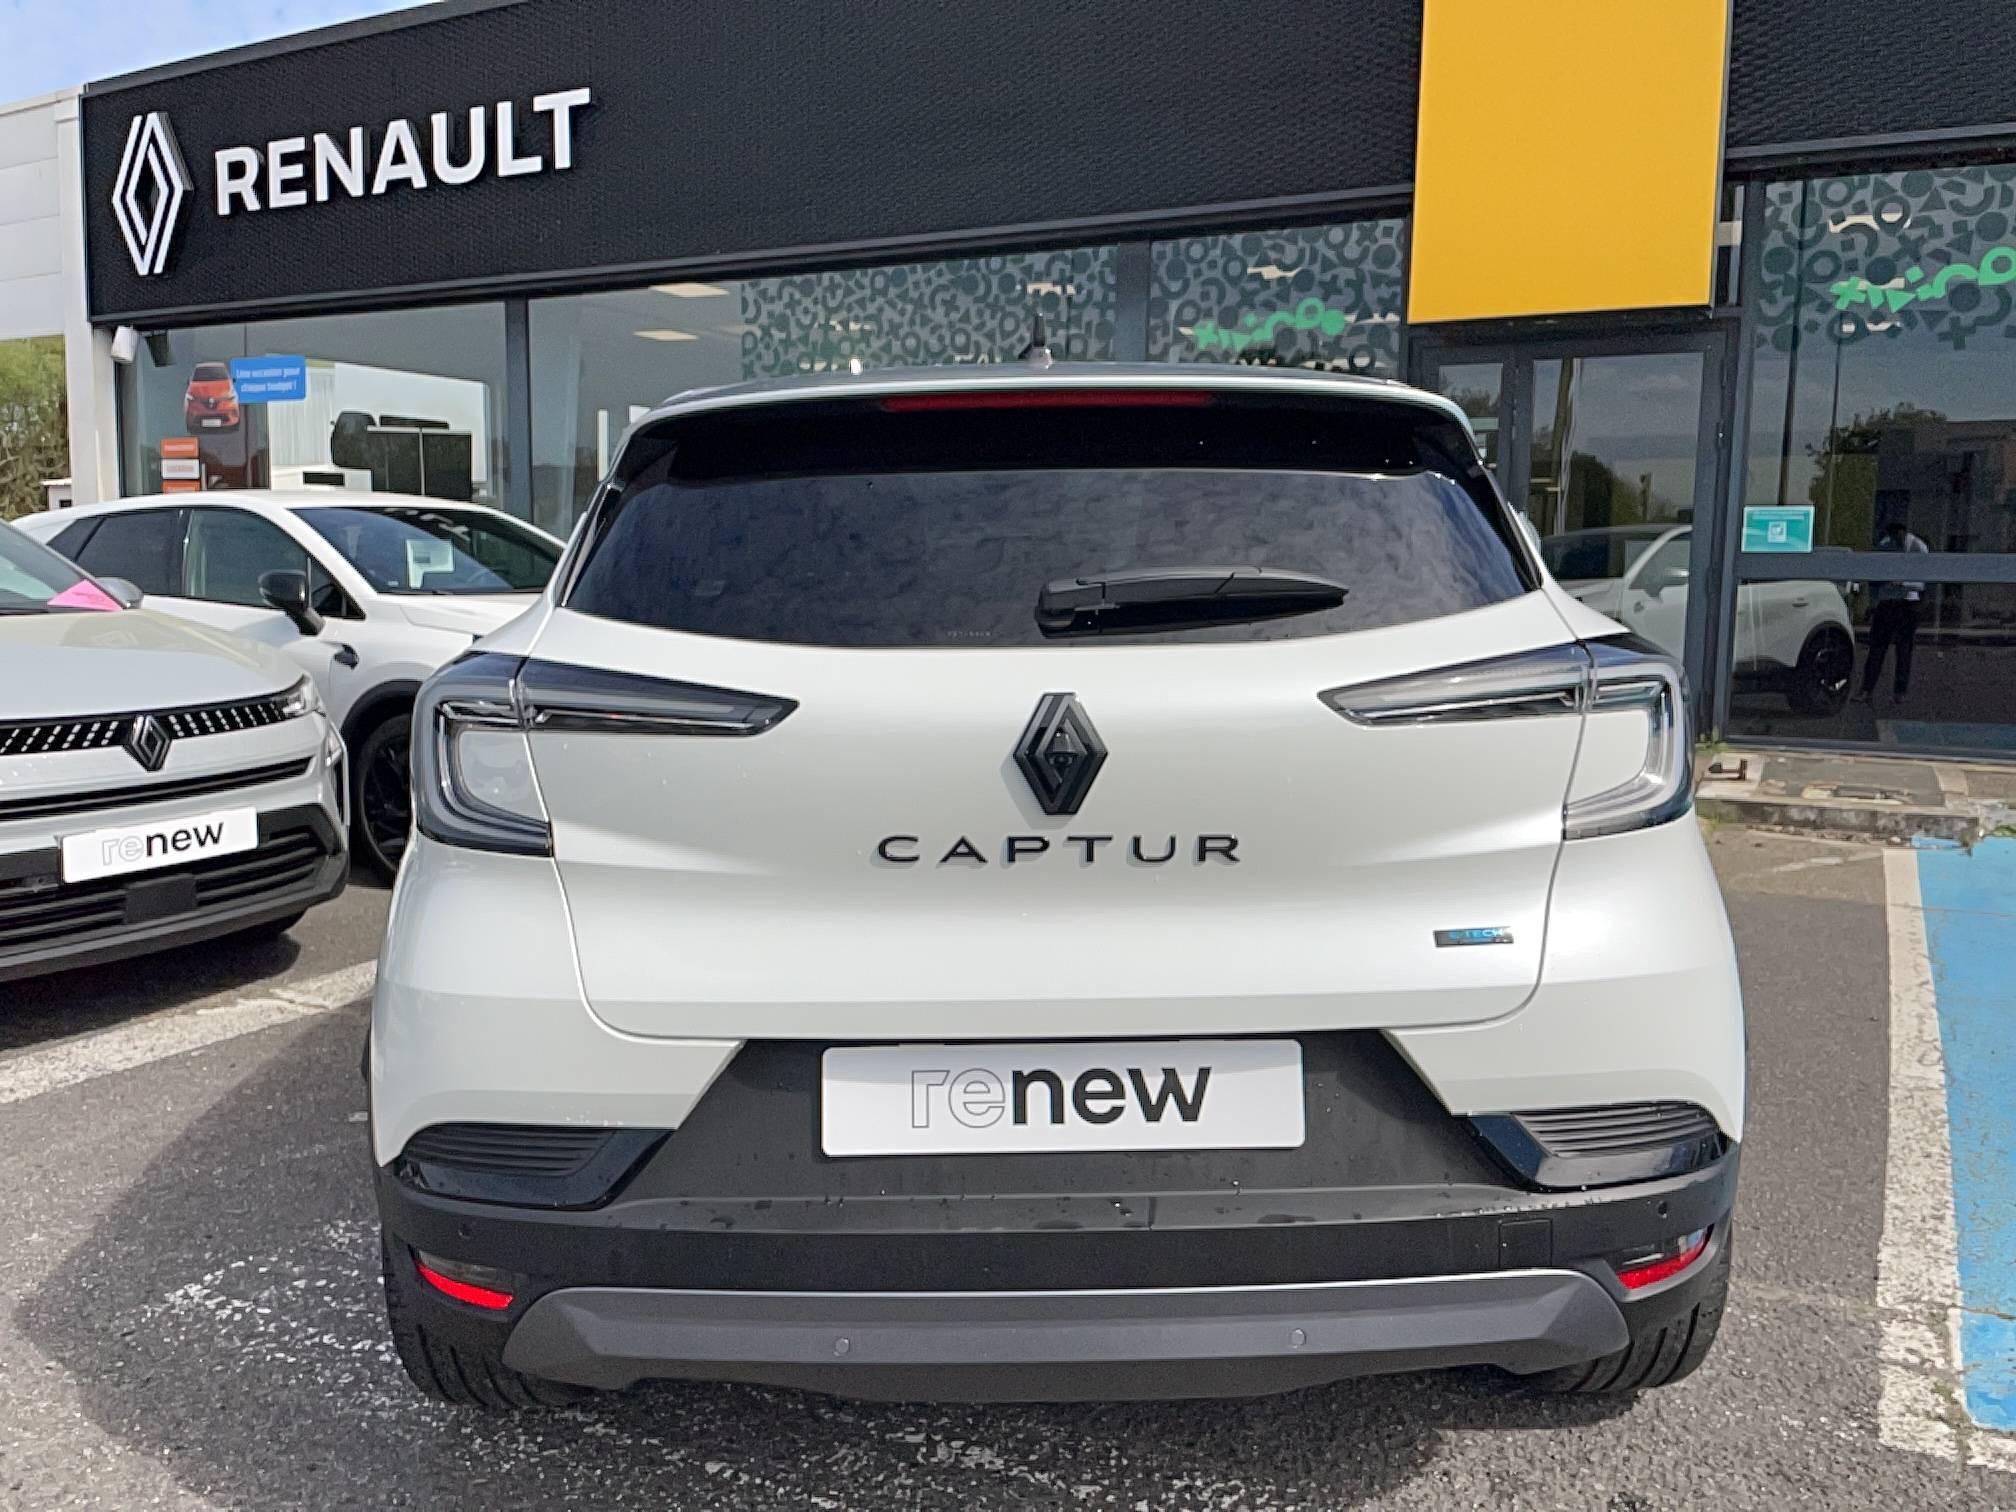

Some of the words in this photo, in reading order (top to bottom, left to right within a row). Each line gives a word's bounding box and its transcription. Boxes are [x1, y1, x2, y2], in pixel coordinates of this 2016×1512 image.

[215, 87, 591, 216] RENAULT
[102, 821, 224, 866] renew
[877, 835, 1241, 864] CAPTUR
[911, 1067, 1212, 1129] renew
